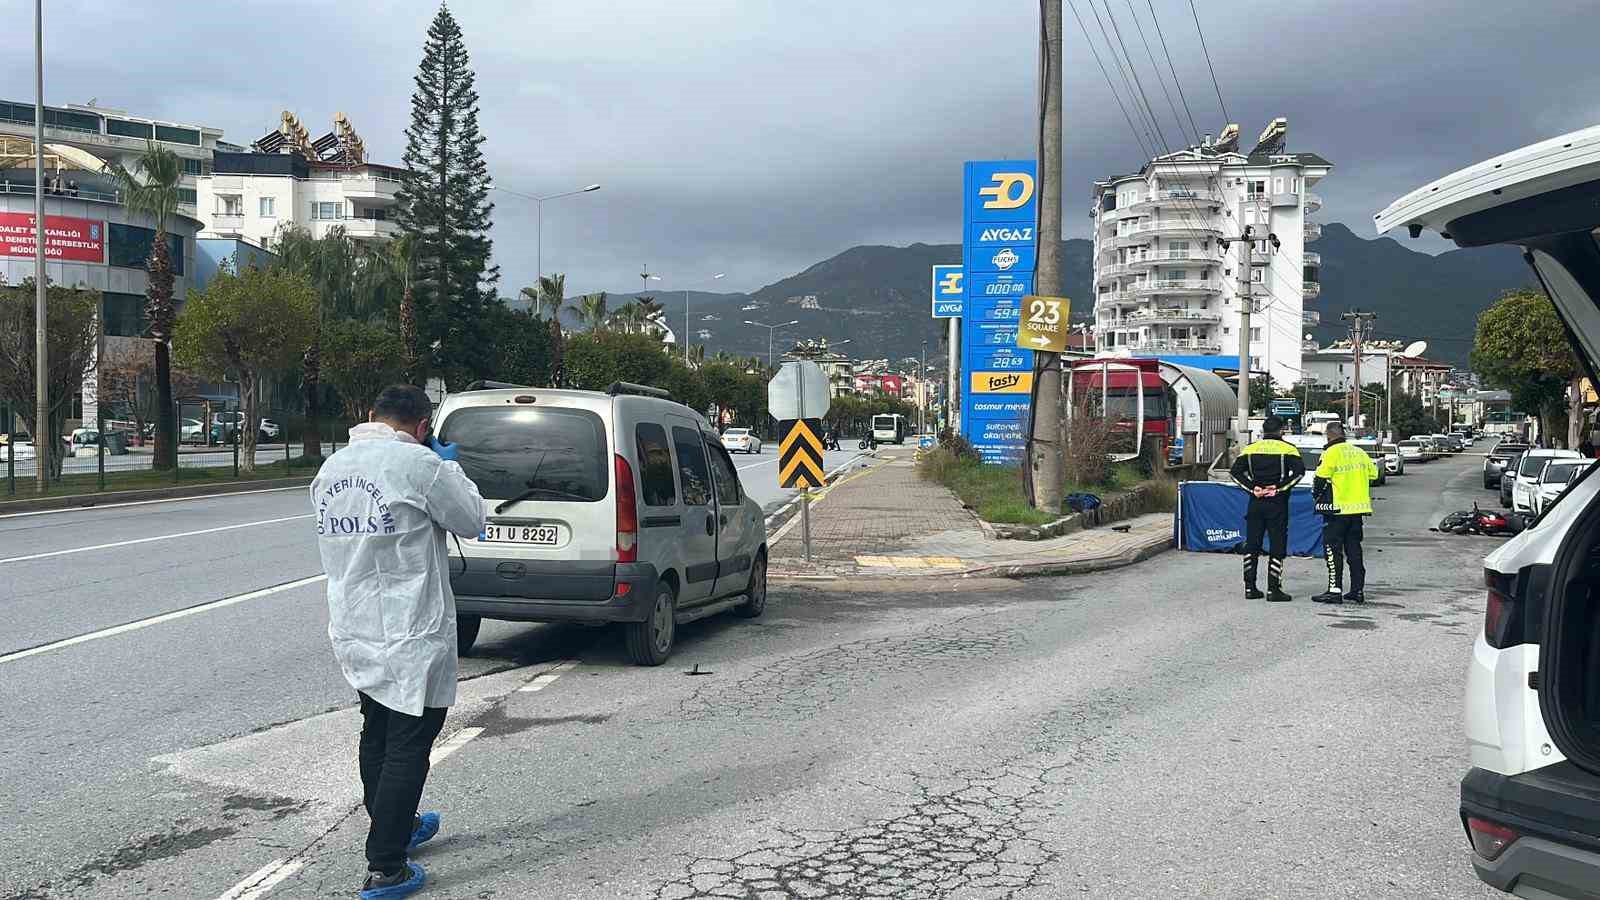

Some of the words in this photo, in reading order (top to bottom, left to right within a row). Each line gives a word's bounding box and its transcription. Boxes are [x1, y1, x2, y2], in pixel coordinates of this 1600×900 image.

[30, 228, 81, 238] BKANLIĞI
[980, 228, 1033, 242] AYGAZ
[10, 246, 63, 256] MÜDÜÜĞÜ
[938, 304, 963, 313] AYGA
[1028, 300, 1061, 325] 23
[1027, 322, 1059, 333] SQUARE
[989, 374, 1020, 391] fasty
[329, 515, 379, 535] POLS
[487, 526, 501, 540] 31
[507, 527, 516, 540] U
[522, 527, 554, 542] 8292
